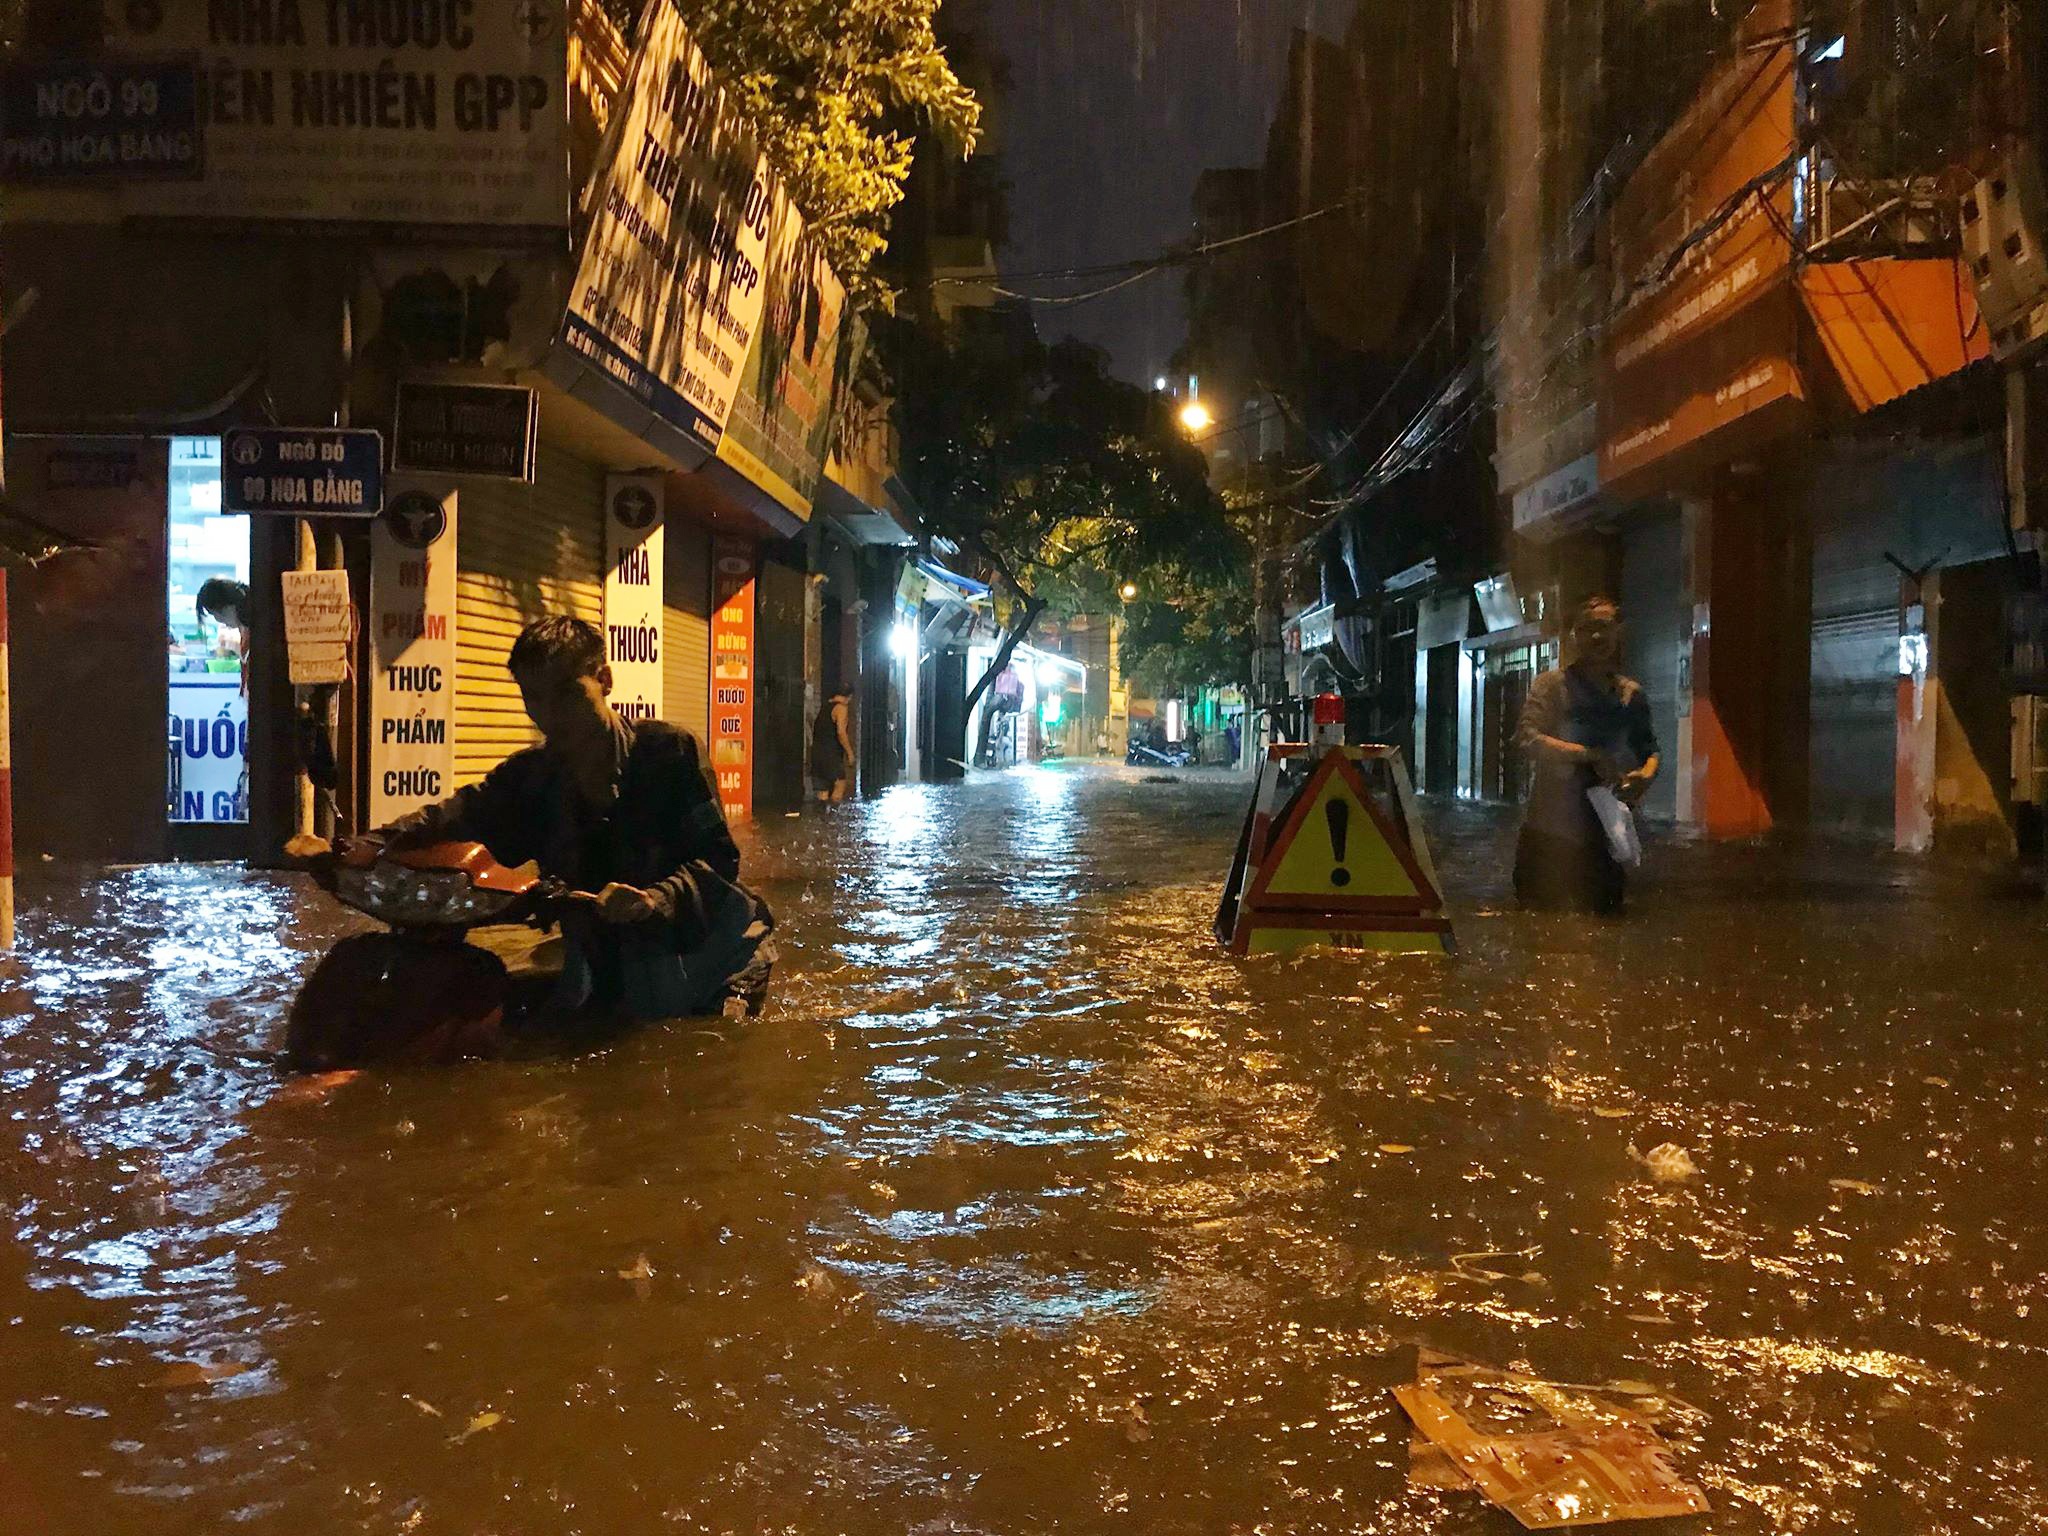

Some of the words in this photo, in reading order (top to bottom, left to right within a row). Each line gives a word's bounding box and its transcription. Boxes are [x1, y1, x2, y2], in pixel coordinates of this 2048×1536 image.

[453, 72, 548, 132] GPP
[271, 477, 307, 503] HOA
[618, 541, 650, 587] NHÀ
[608, 613, 659, 665] THUỐC
[388, 663, 442, 698] THỰC
[381, 707, 445, 745] PHẨM
[383, 763, 442, 797] CHỨC
